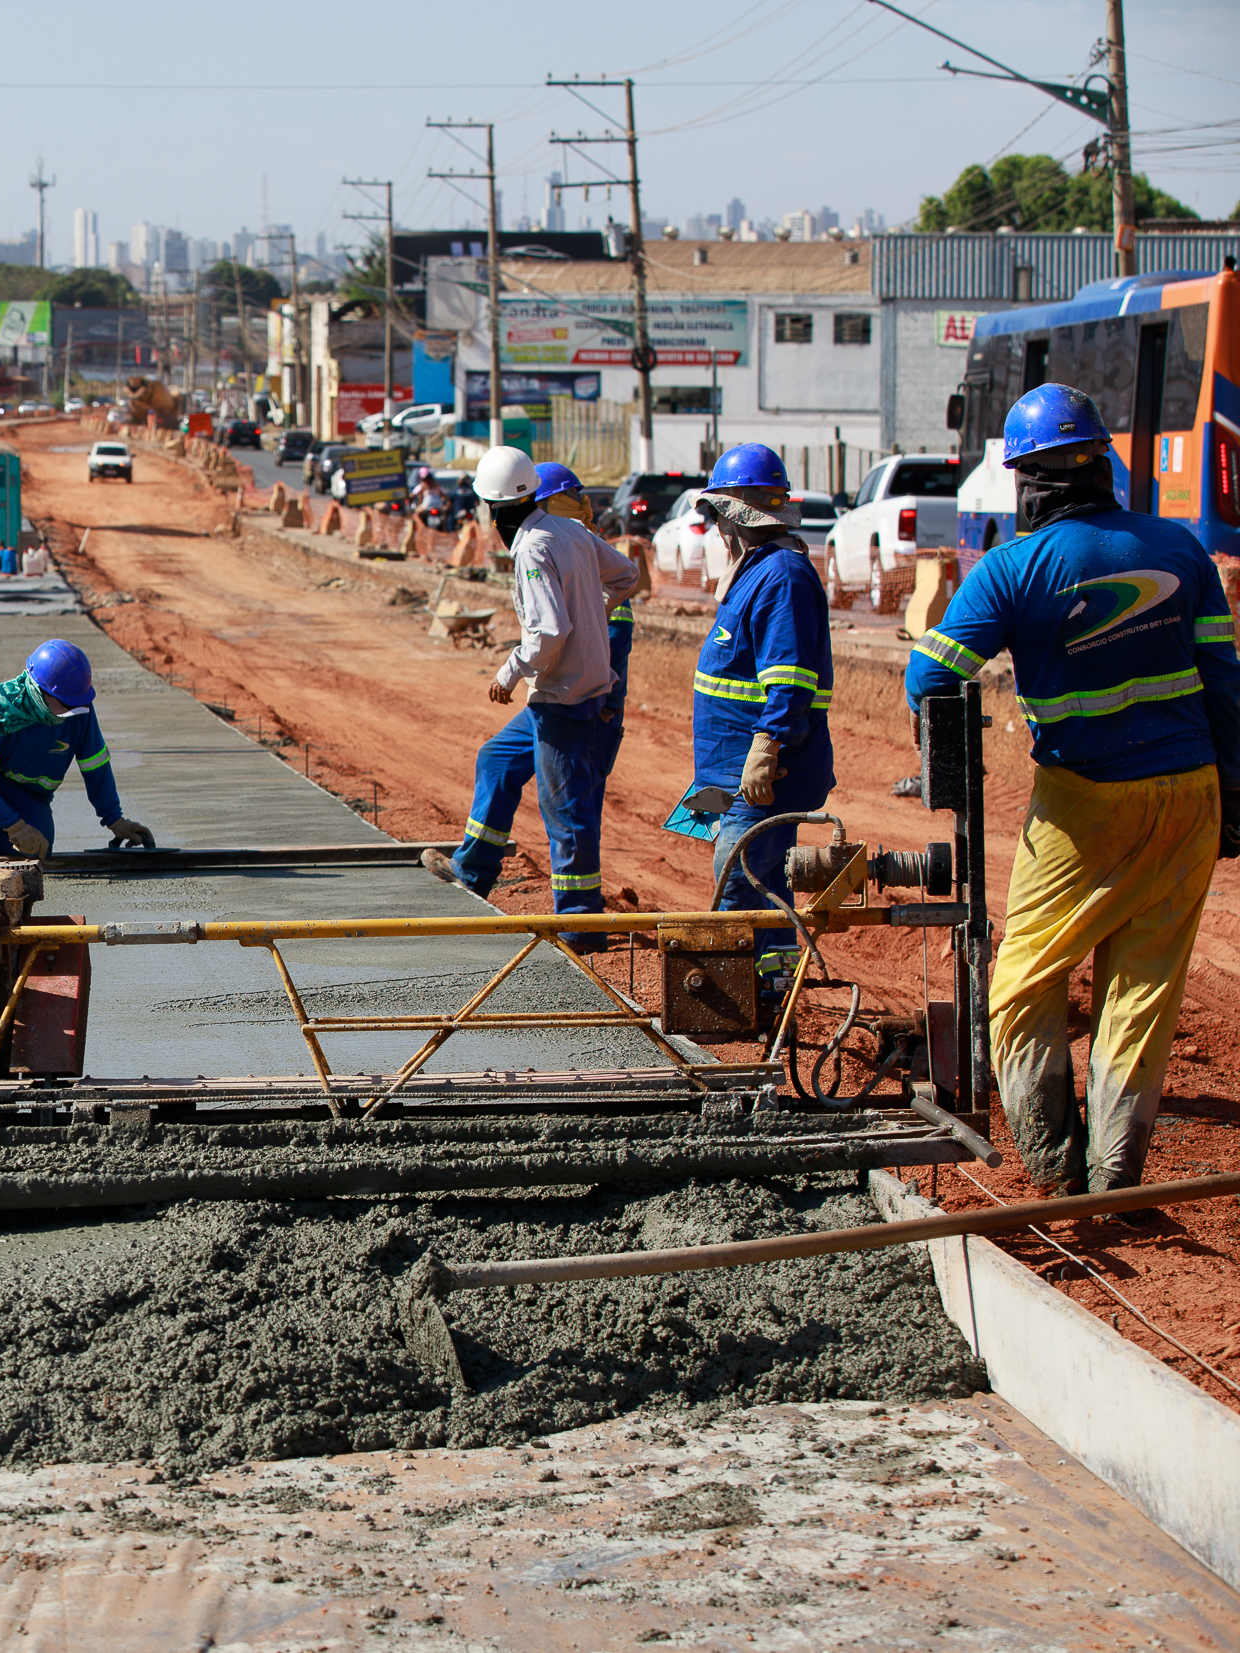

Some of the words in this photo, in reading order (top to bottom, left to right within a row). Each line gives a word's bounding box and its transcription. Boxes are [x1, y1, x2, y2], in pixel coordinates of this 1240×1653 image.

[1067, 638, 1108, 655] CONSÓRCIO
[1107, 623, 1150, 643] CONSTRUTOR
[1149, 619, 1163, 629] BRT
